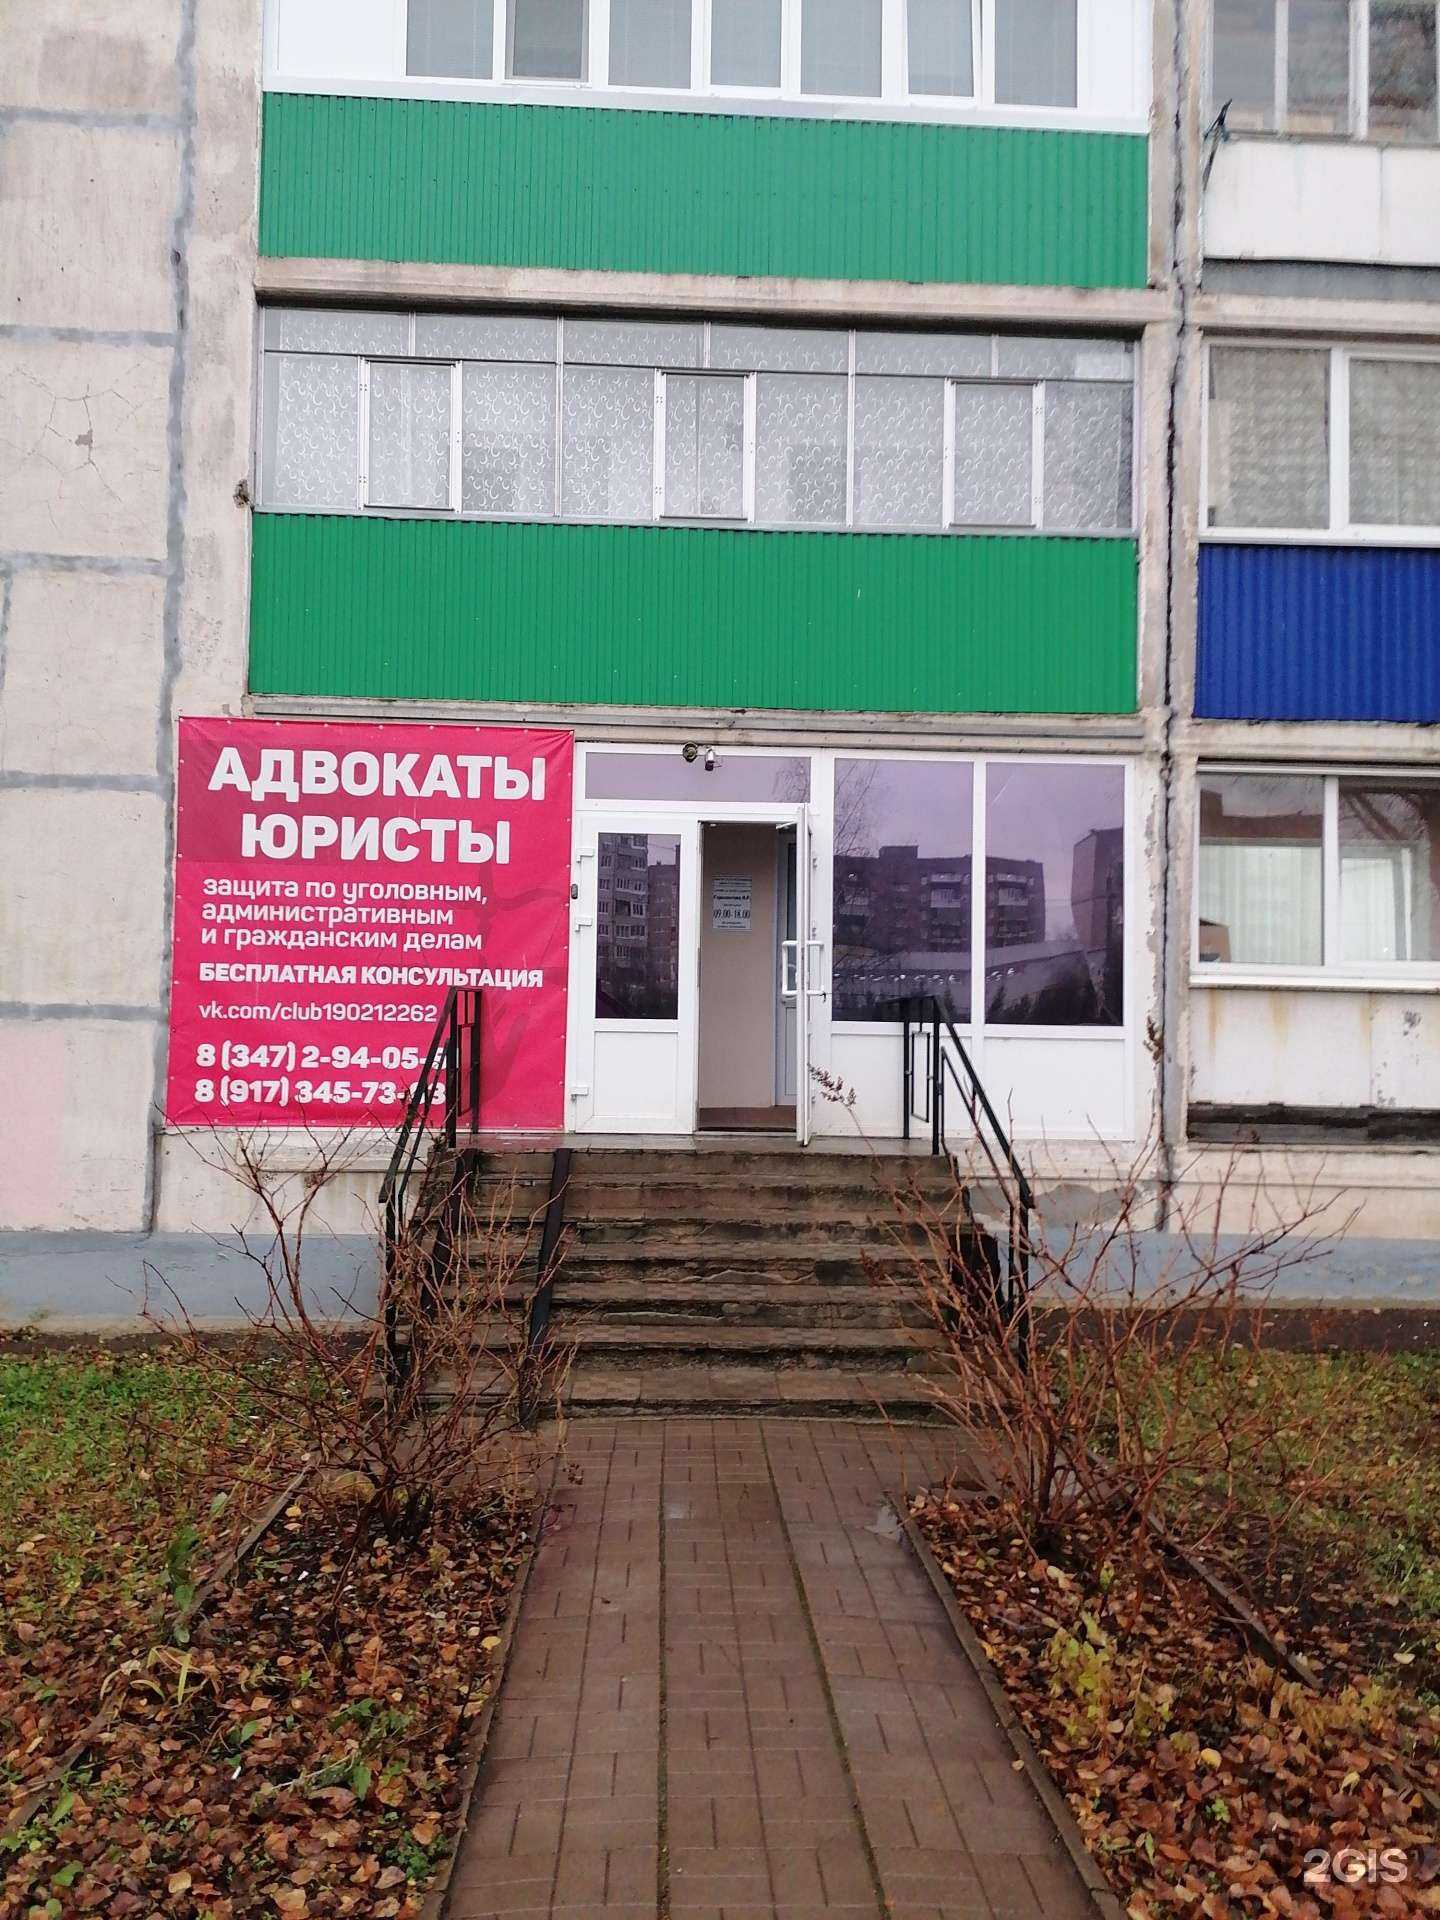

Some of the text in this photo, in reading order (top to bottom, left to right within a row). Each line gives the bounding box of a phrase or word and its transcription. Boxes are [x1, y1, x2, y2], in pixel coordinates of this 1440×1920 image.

[208, 747, 546, 802] АДВОКАТЫ
[241, 813, 510, 864] ЮРИСТЫ
[202, 878, 487, 905] защита по уголовным,
[201, 902, 454, 928] административным
[201, 928, 482, 952] и гражданским делам
[199, 962, 544, 990] БЕСПЛАТНАЯ КОНСУЛЬТАЦИЯ
[199, 1000, 438, 1022] vk.com/club190212262
[196, 1043, 216, 1067] 8
[221, 1040, 296, 1072] (347)
[194, 1079, 214, 1102] 8
[220, 1075, 289, 1107] (917)
